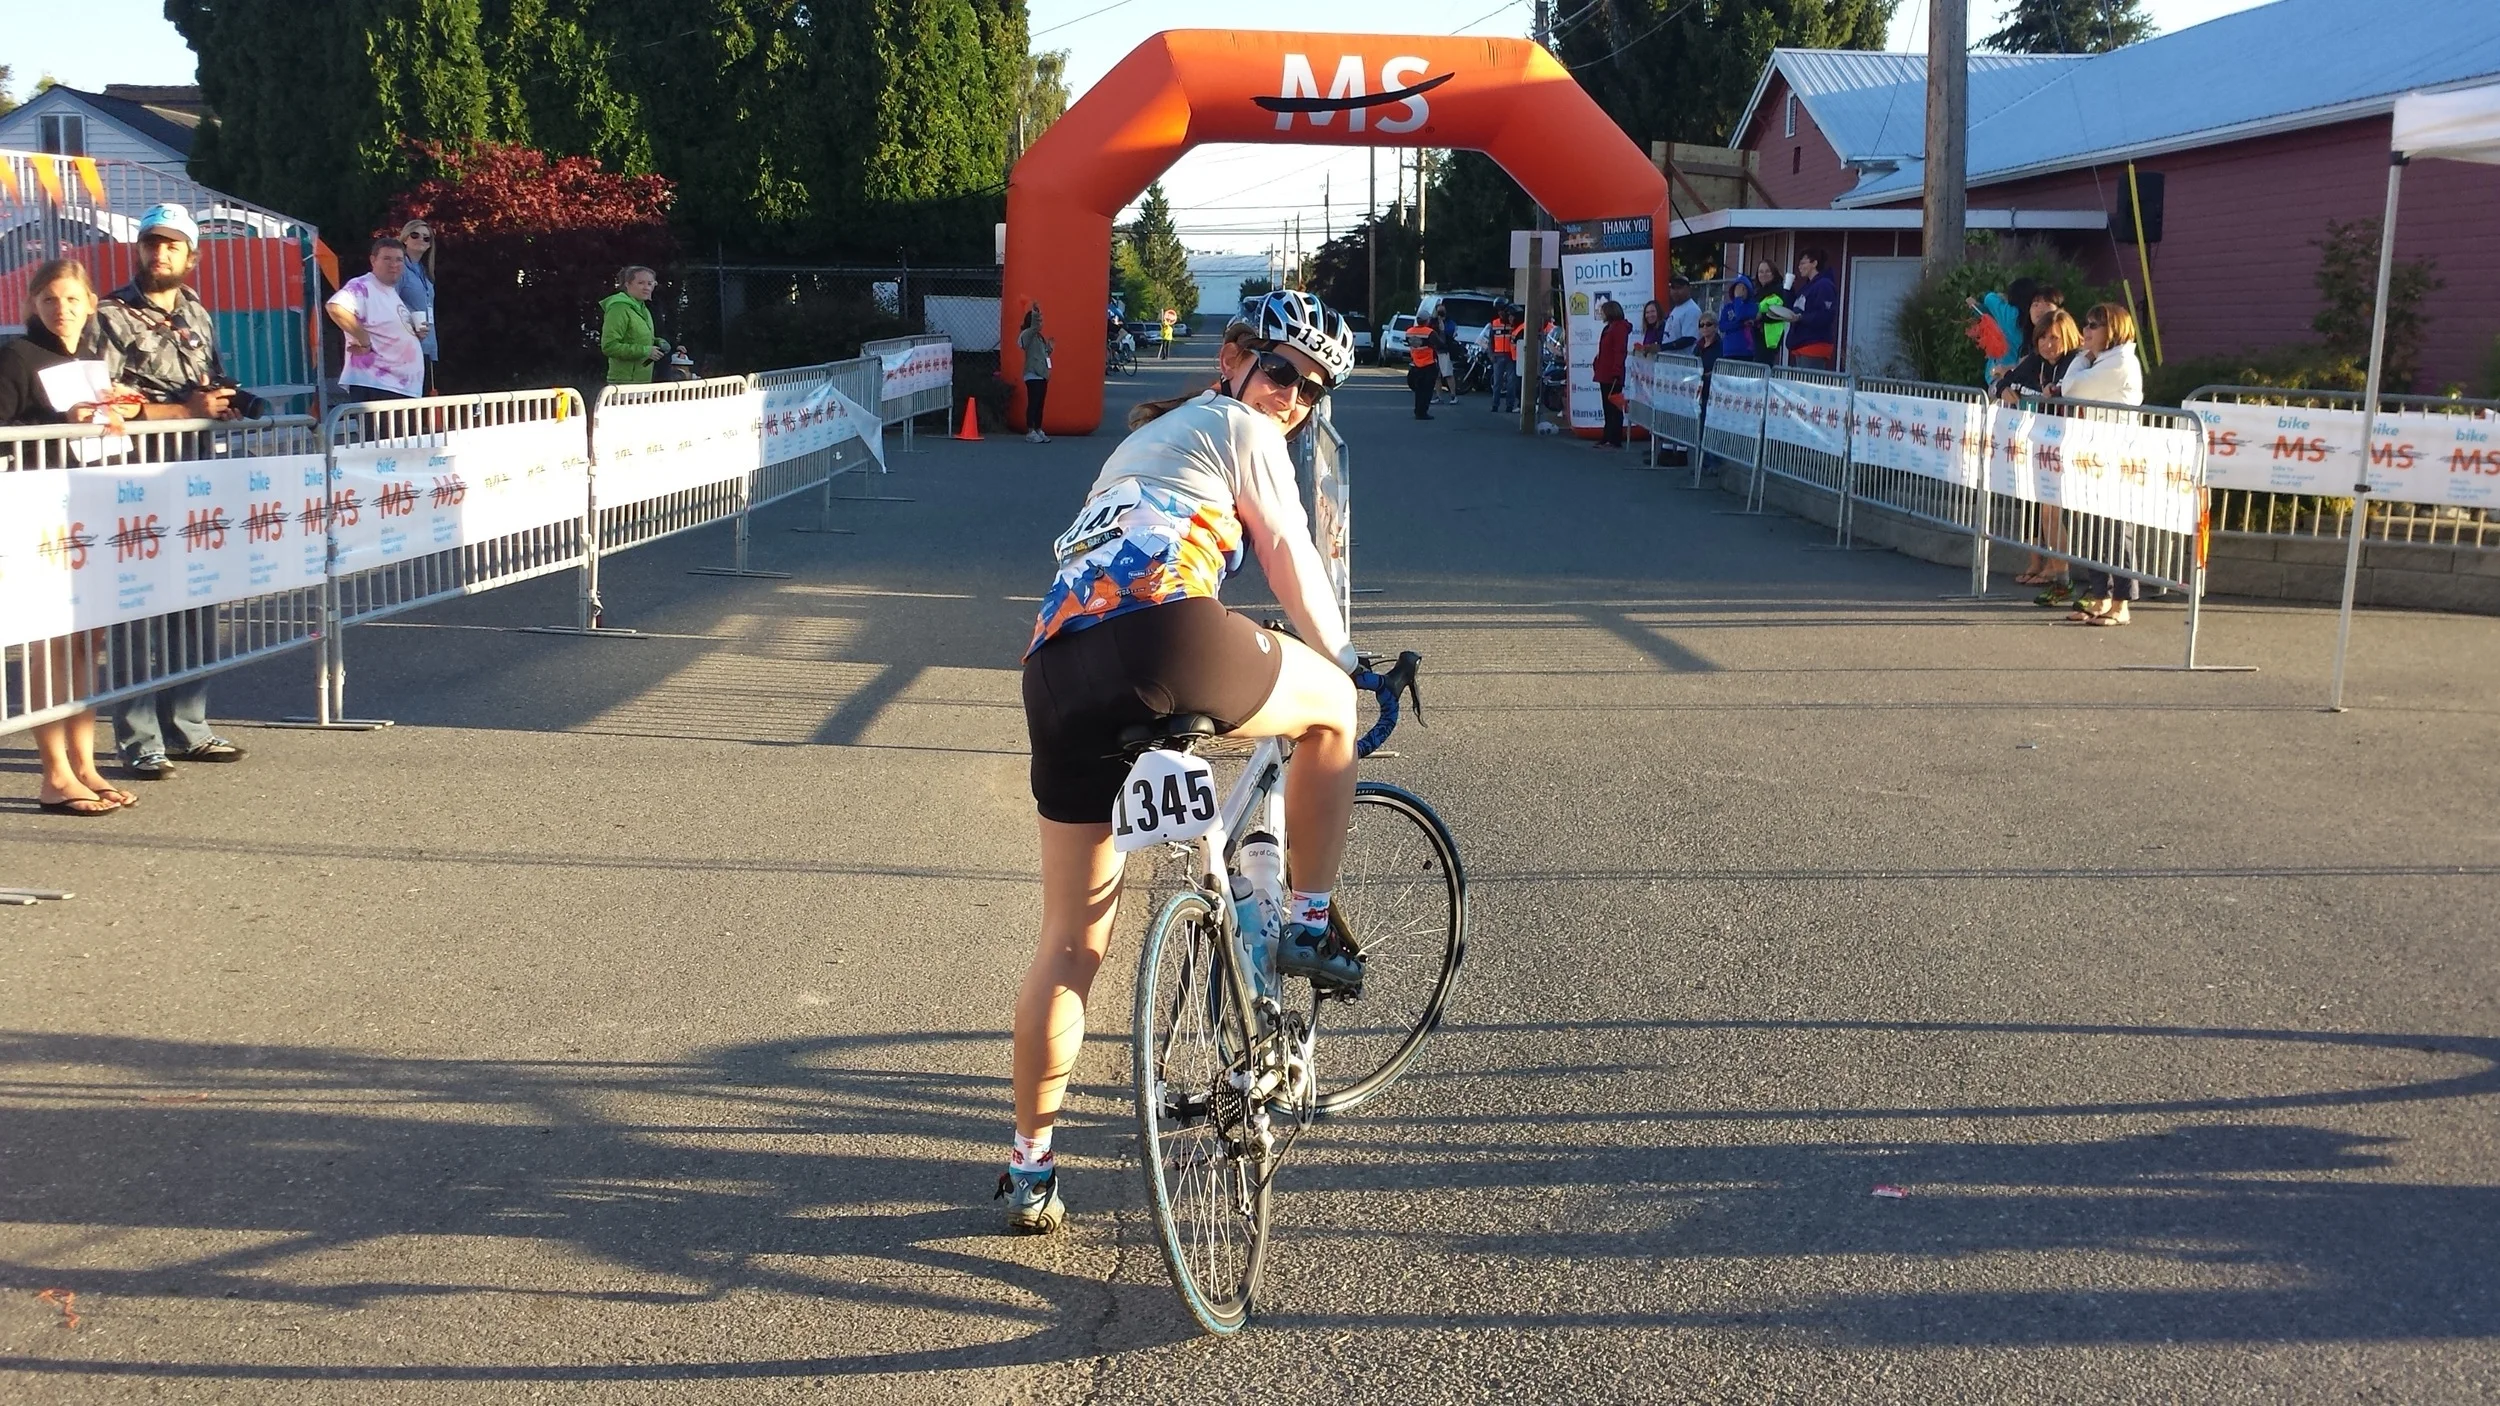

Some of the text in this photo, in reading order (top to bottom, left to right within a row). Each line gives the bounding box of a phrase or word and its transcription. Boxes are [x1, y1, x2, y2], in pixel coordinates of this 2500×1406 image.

[1274, 53, 1431, 134] MS
[1602, 219, 1649, 235] THANK YOU
[1603, 233, 1648, 248] SPONSORS
[1298, 328, 1342, 366] 1345
[1867, 415, 1882, 438] MS
[2198, 409, 2221, 425] ike
[2277, 416, 2310, 431] bike
[1911, 422, 1927, 446] MS
[1935, 425, 1951, 451] MS
[2456, 428, 2488, 443] bike
[2039, 444, 2061, 473] MS
[2272, 435, 2327, 463] MS
[2450, 447, 2500, 475] MS
[187, 474, 212, 498] bike
[248, 471, 271, 492] bike
[304, 467, 323, 487] bike
[117, 481, 144, 504] bike
[381, 480, 415, 519] MS
[433, 473, 465, 509] MS
[187, 506, 225, 553] MS
[248, 501, 282, 544] MS
[304, 497, 327, 536] M
[117, 514, 160, 563] MS
[1116, 769, 1215, 837] 1345
